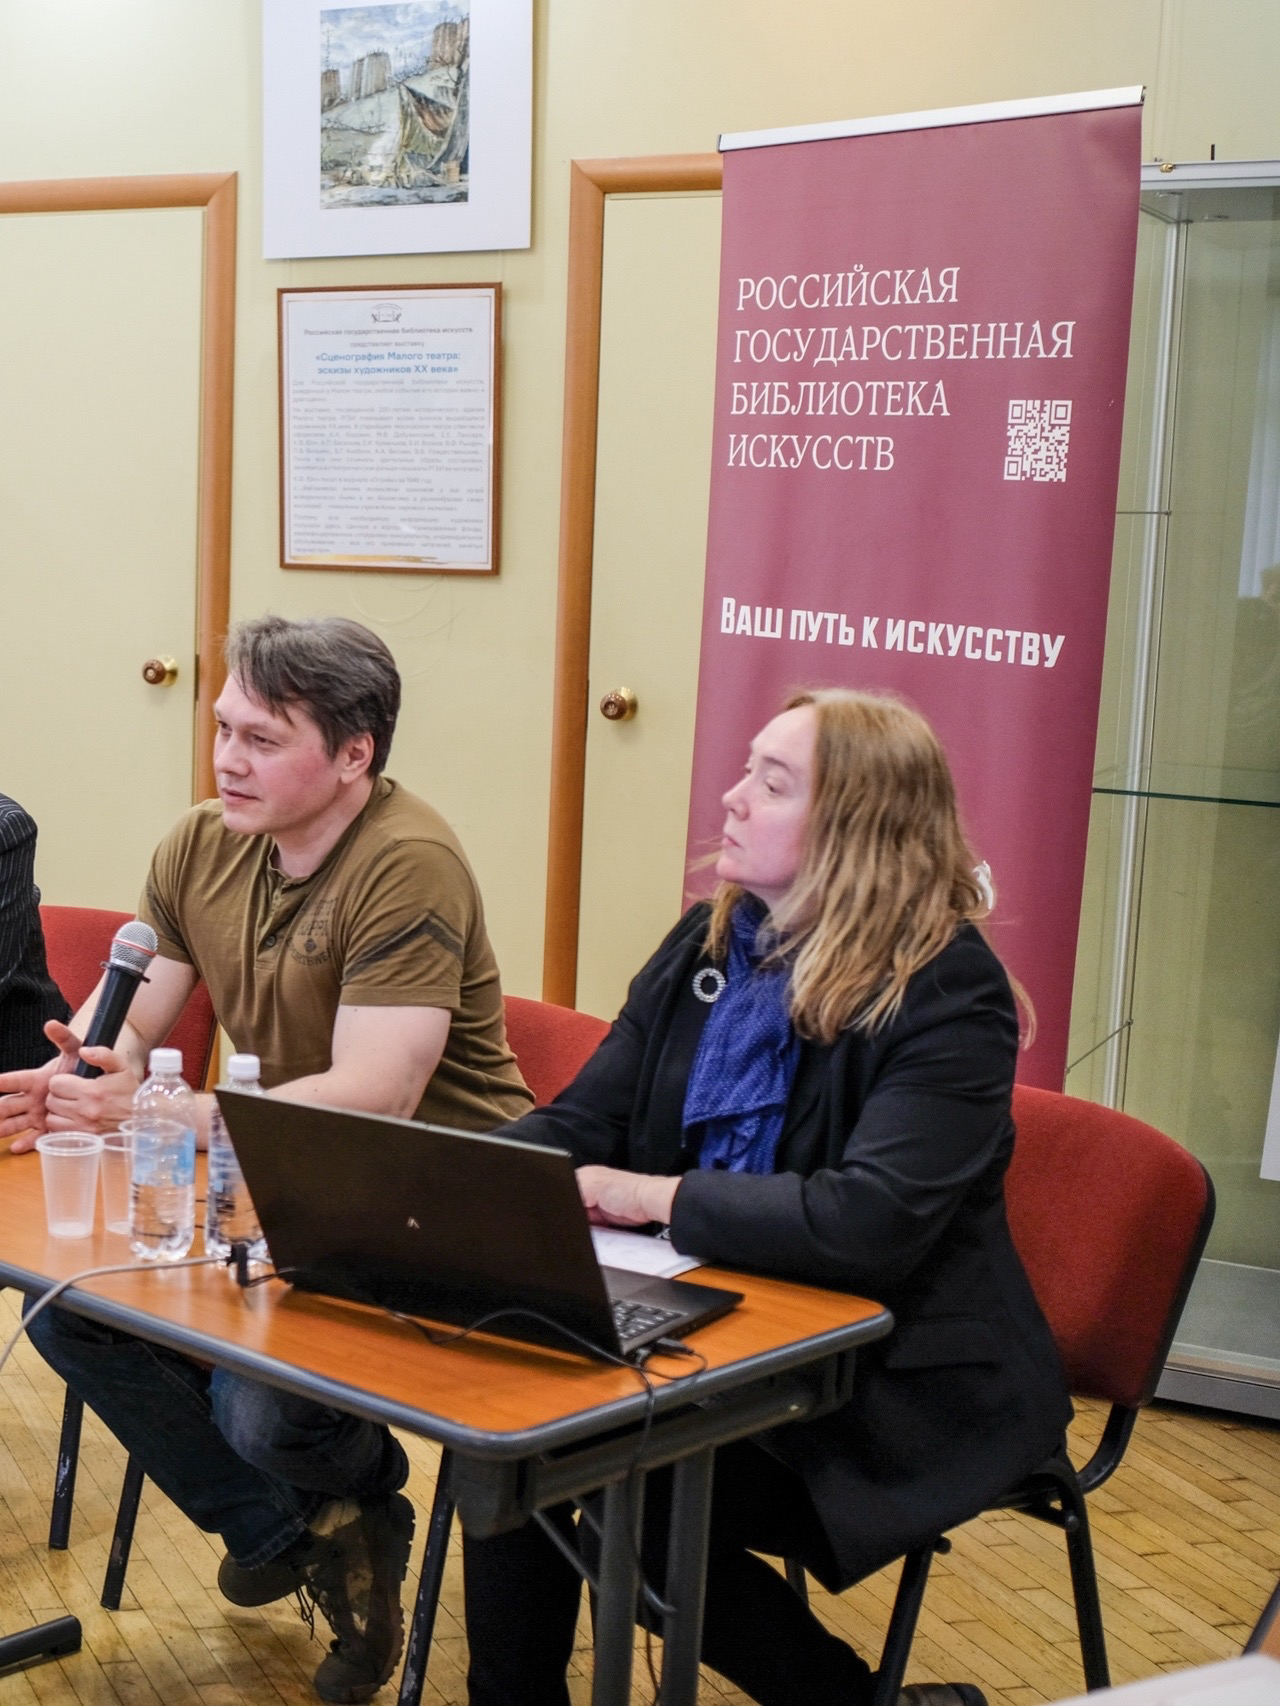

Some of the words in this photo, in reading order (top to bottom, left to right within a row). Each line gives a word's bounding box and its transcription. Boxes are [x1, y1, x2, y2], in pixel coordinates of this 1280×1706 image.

[736, 263, 960, 311] РОССИЙСКАЯ
[315, 352, 385, 363] «Сценография
[387, 351, 423, 361] Малого
[426, 351, 462, 362] театра:
[733, 320, 1077, 368] ГОСУДАРСТВЕННАЯ
[317, 366, 352, 375] эскизы
[353, 366, 412, 376] художников
[431, 365, 459, 374] века»
[730, 379, 951, 417] БИБЛИОТЕКА
[727, 433, 895, 471] ИСКУССТВ
[720, 597, 783, 639] ВАШ
[789, 608, 855, 647] ПУТЬ
[862, 615, 880, 649] К
[885, 618, 1066, 668] ИСКУССТВУ
